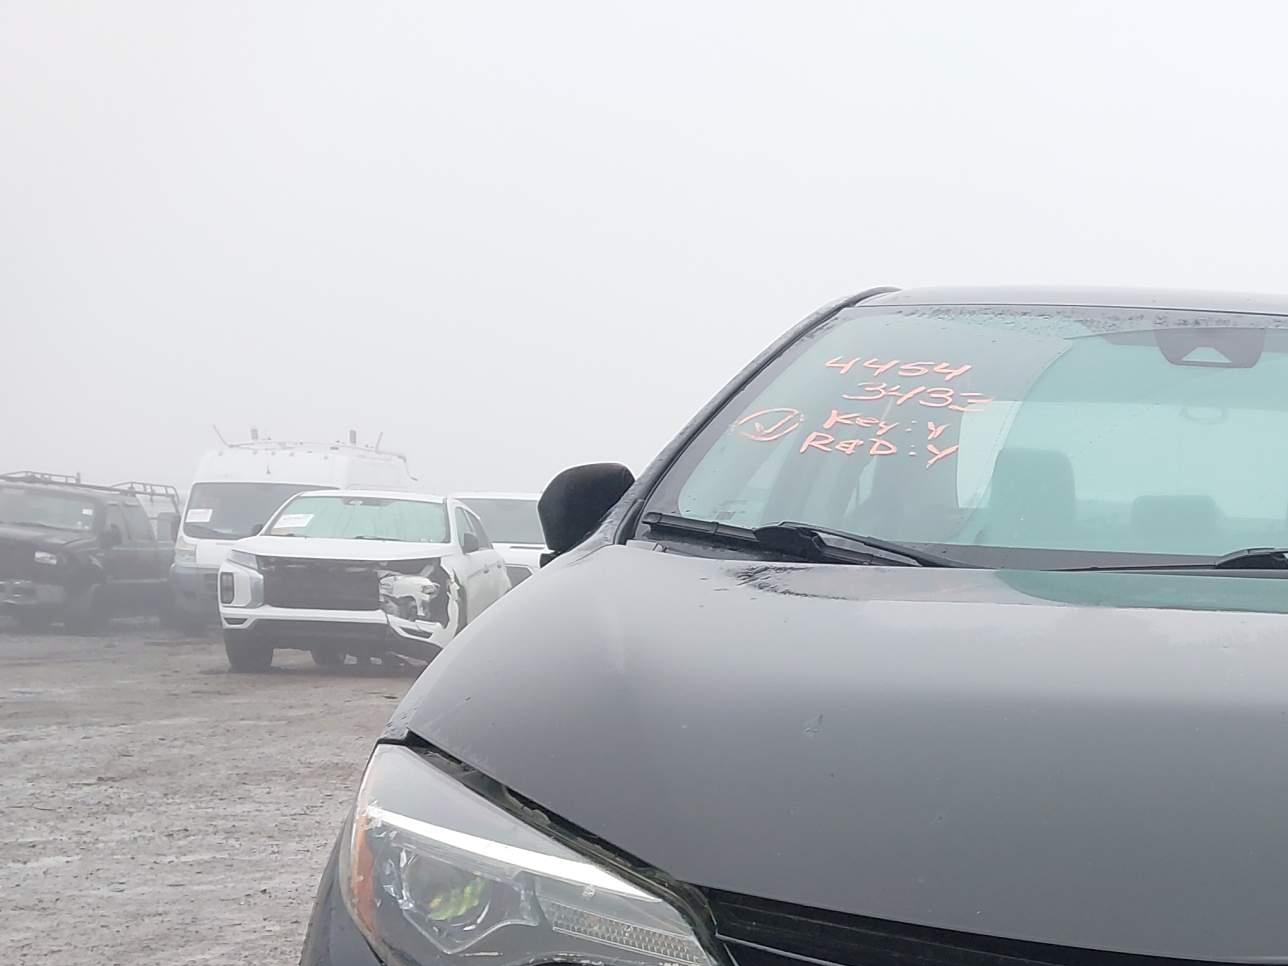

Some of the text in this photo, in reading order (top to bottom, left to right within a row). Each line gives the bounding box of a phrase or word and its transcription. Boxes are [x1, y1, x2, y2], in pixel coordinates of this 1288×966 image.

[825, 356, 974, 381] 4454
[842, 382, 994, 412] 3433
[926, 443, 960, 469] Y
